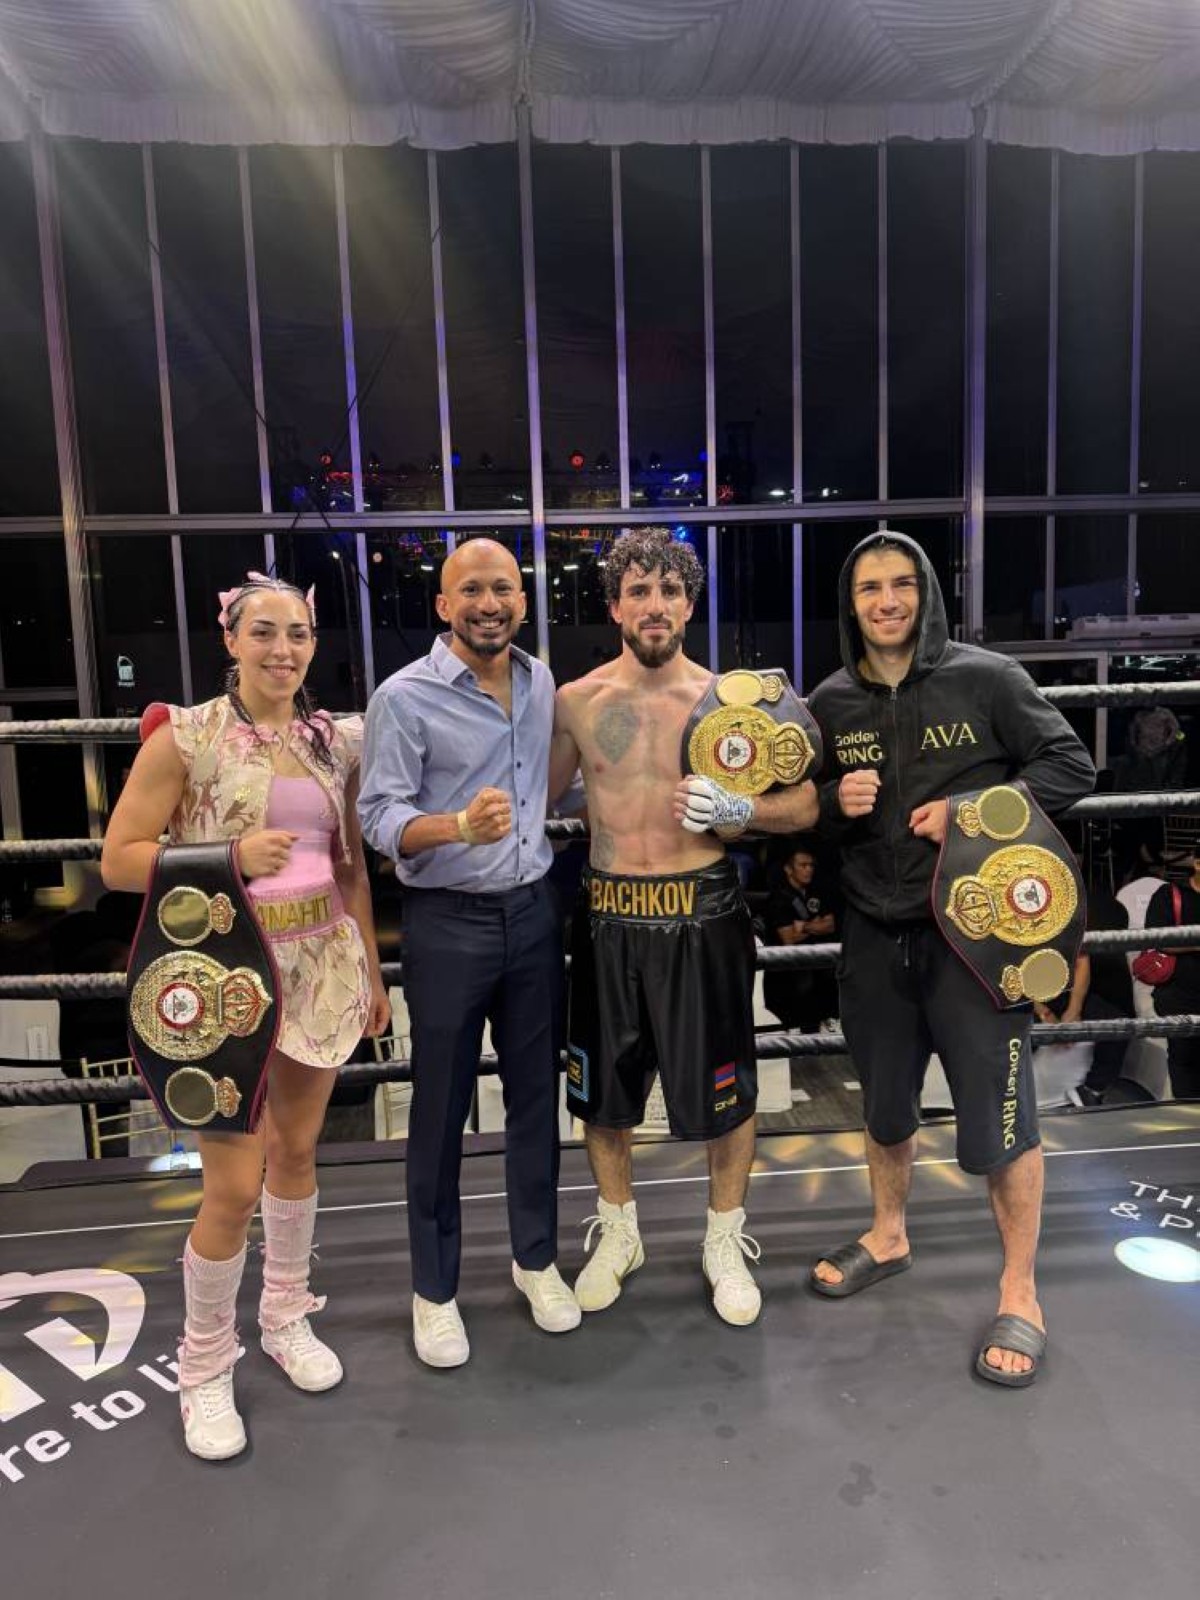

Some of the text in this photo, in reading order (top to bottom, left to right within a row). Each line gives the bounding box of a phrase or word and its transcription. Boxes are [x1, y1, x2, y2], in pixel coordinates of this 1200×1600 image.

[920, 722, 978, 750] AVA
[836, 744, 883, 766] RING
[591, 878, 695, 917] BACHKOV
[1003, 1099, 1018, 1149] RING
[1129, 1180, 1200, 1212] TH
[1109, 1202, 1200, 1238] & P
[70, 1390, 146, 1431] to
